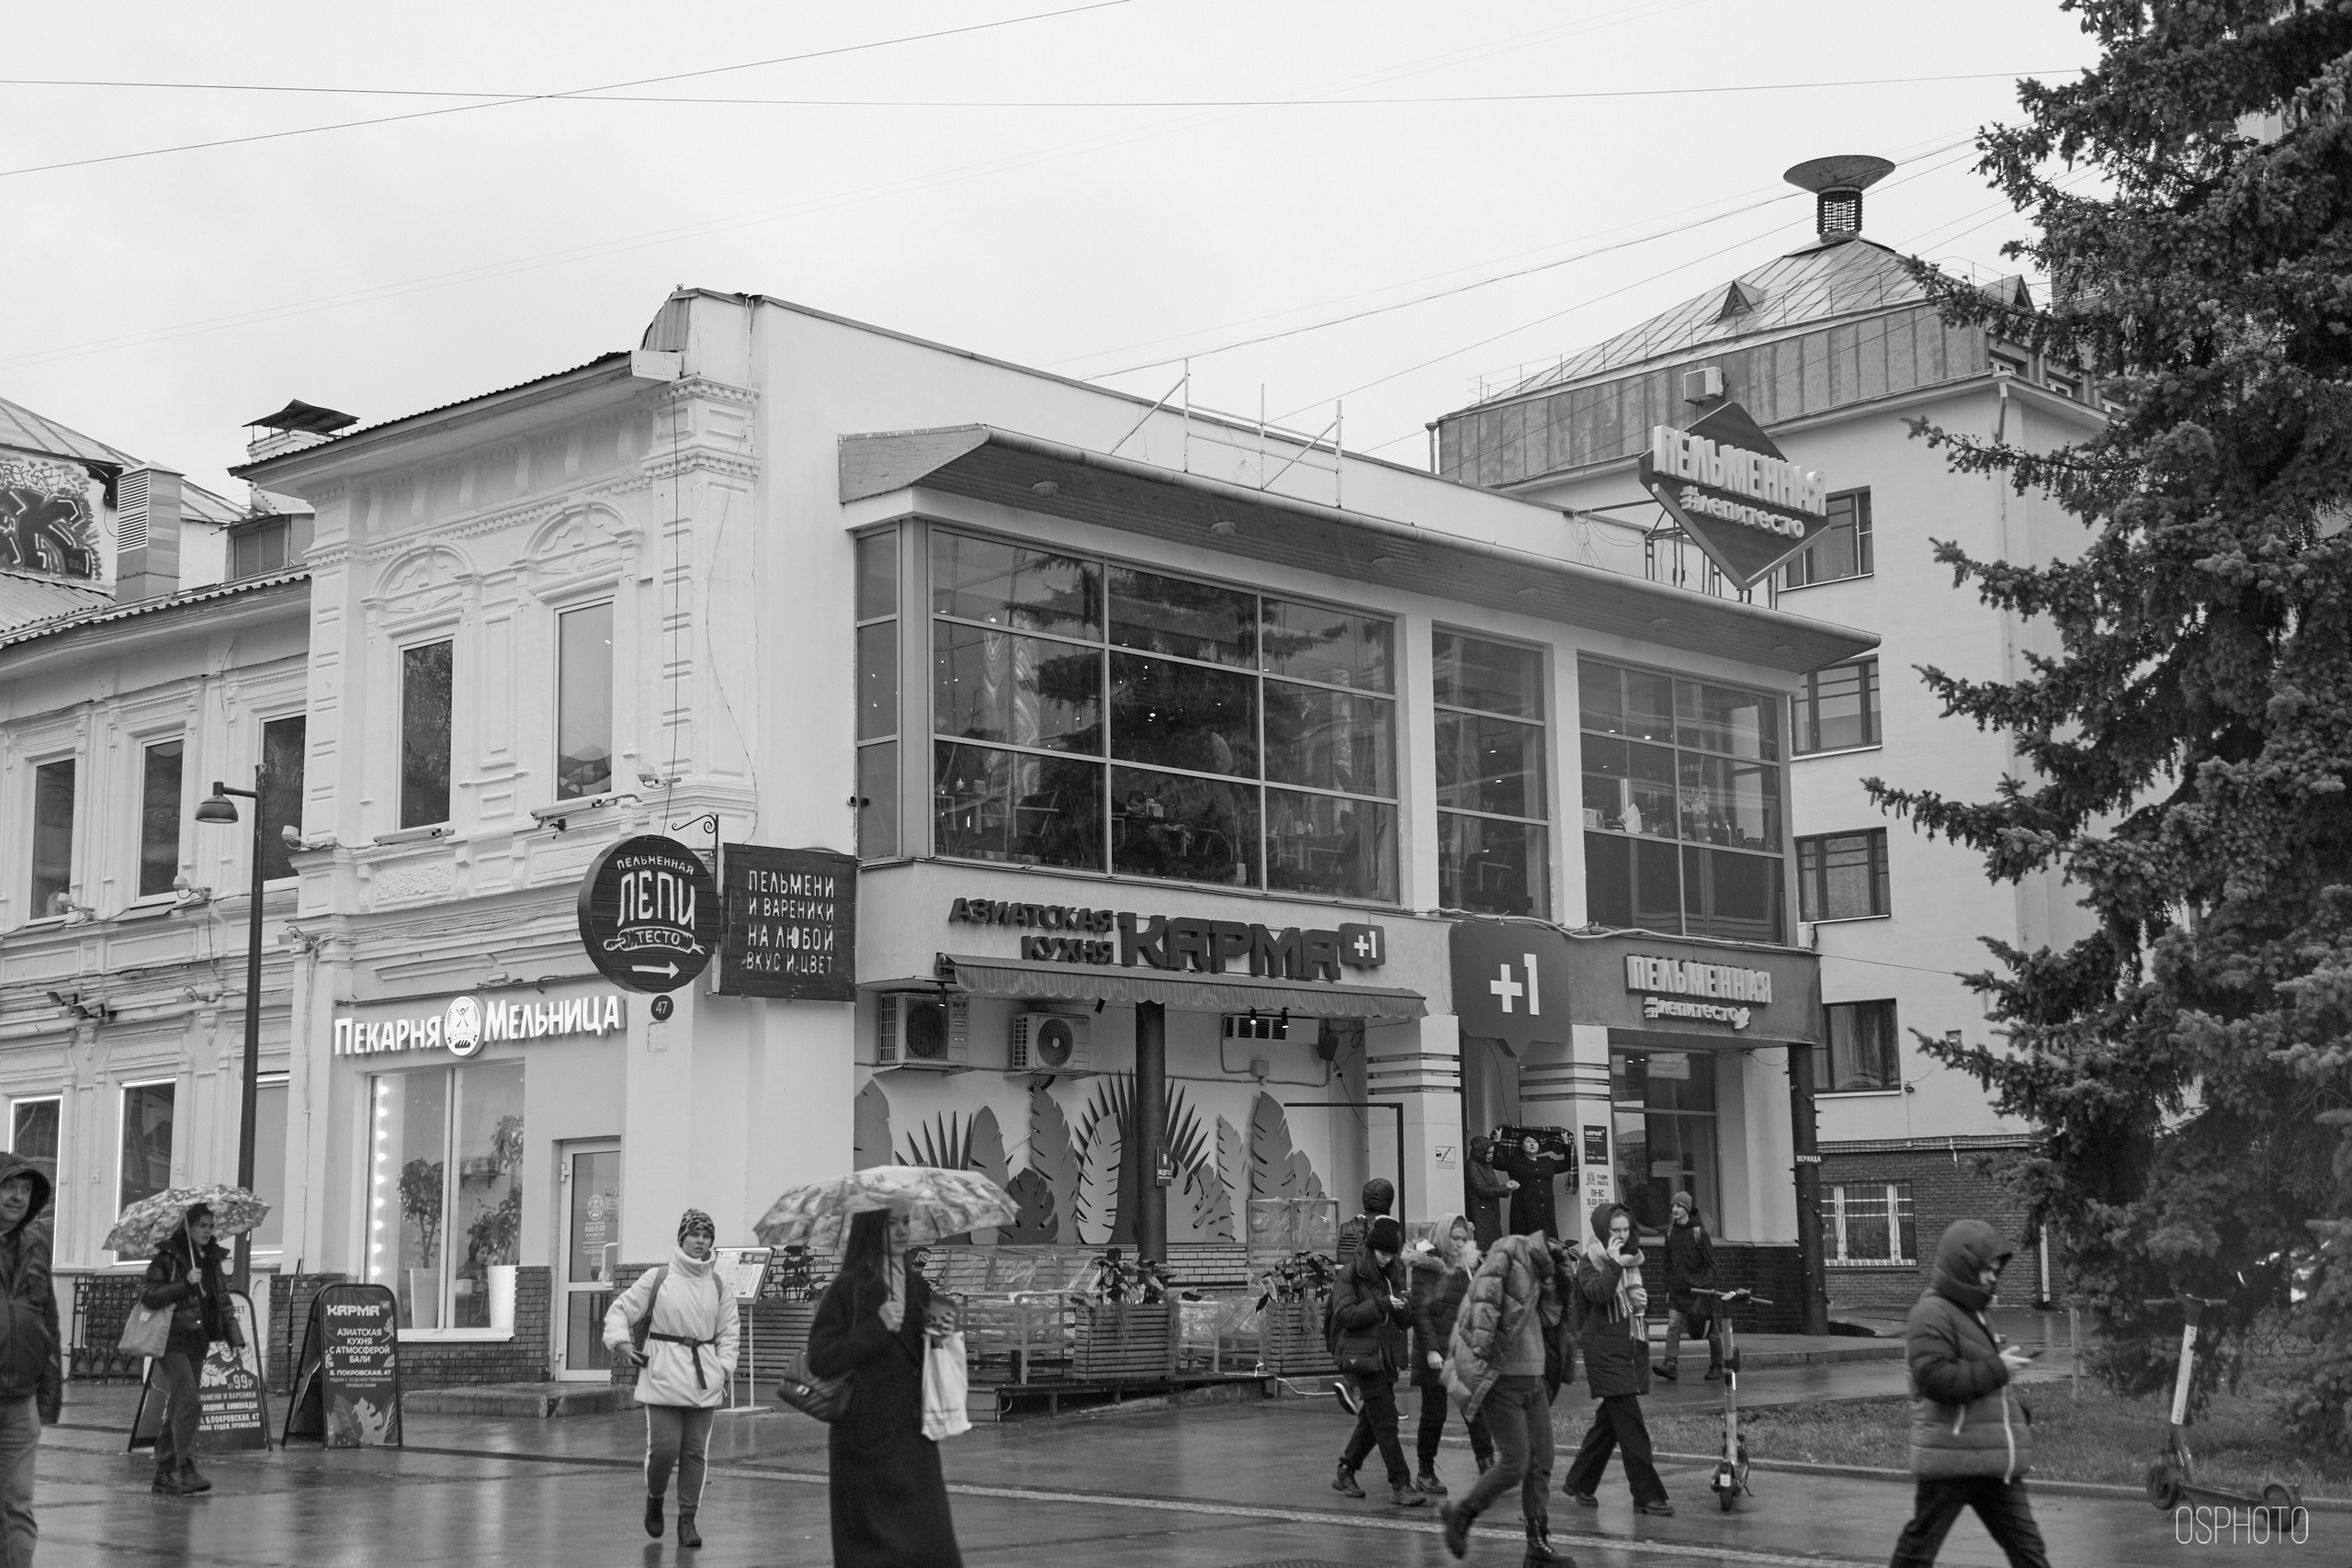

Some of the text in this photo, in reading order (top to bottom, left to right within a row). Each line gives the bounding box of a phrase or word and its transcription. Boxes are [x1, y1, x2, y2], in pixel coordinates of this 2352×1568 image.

[1653, 424, 1826, 516] ПЕЛЬМЕННАЯ
[1679, 485, 1805, 539] #лепитесто
[616, 855, 695, 875] ПЕЛЬМЕННАЯ
[748, 869, 834, 898] ПЕЛЬМЕНИ
[616, 869, 696, 931] ЛЕПИ
[749, 896, 834, 921] И ВАРЕНИКИ
[949, 897, 1114, 932] АЗИАТСКАЯ
[636, 930, 681, 945] ТЕСТО
[748, 922, 833, 951] НА ЛЮБОЙ
[1117, 911, 1377, 981] КАРМА +1
[1021, 935, 1114, 964] КУХНЯ
[746, 951, 832, 976] ВКУС И ЦВЕТ
[1490, 953, 1540, 1016] +1
[1624, 953, 1773, 1004] ПЕЛЬМЕННАЯ
[655, 1001, 668, 1014] 47
[1643, 996, 1741, 1022] #лепитесто
[334, 995, 625, 1055] ПЕКАРНЯ МЕЛЬНИЦА
[1796, 1155, 1821, 1163] ВЕРАНДА
[326, 1304, 379, 1316] КАРМА
[336, 1328, 382, 1337] АЗИАТСКАЯ
[329, 1344, 390, 1354] С АТМОСФЕРОЙ
[349, 1355, 371, 1363] БАЛИ
[226, 1401, 257, 1410] ЛИМОНАДЫ
[228, 1391, 256, 1400] ВАРЕНИКИ
[252, 1413, 259, 1421] 47
